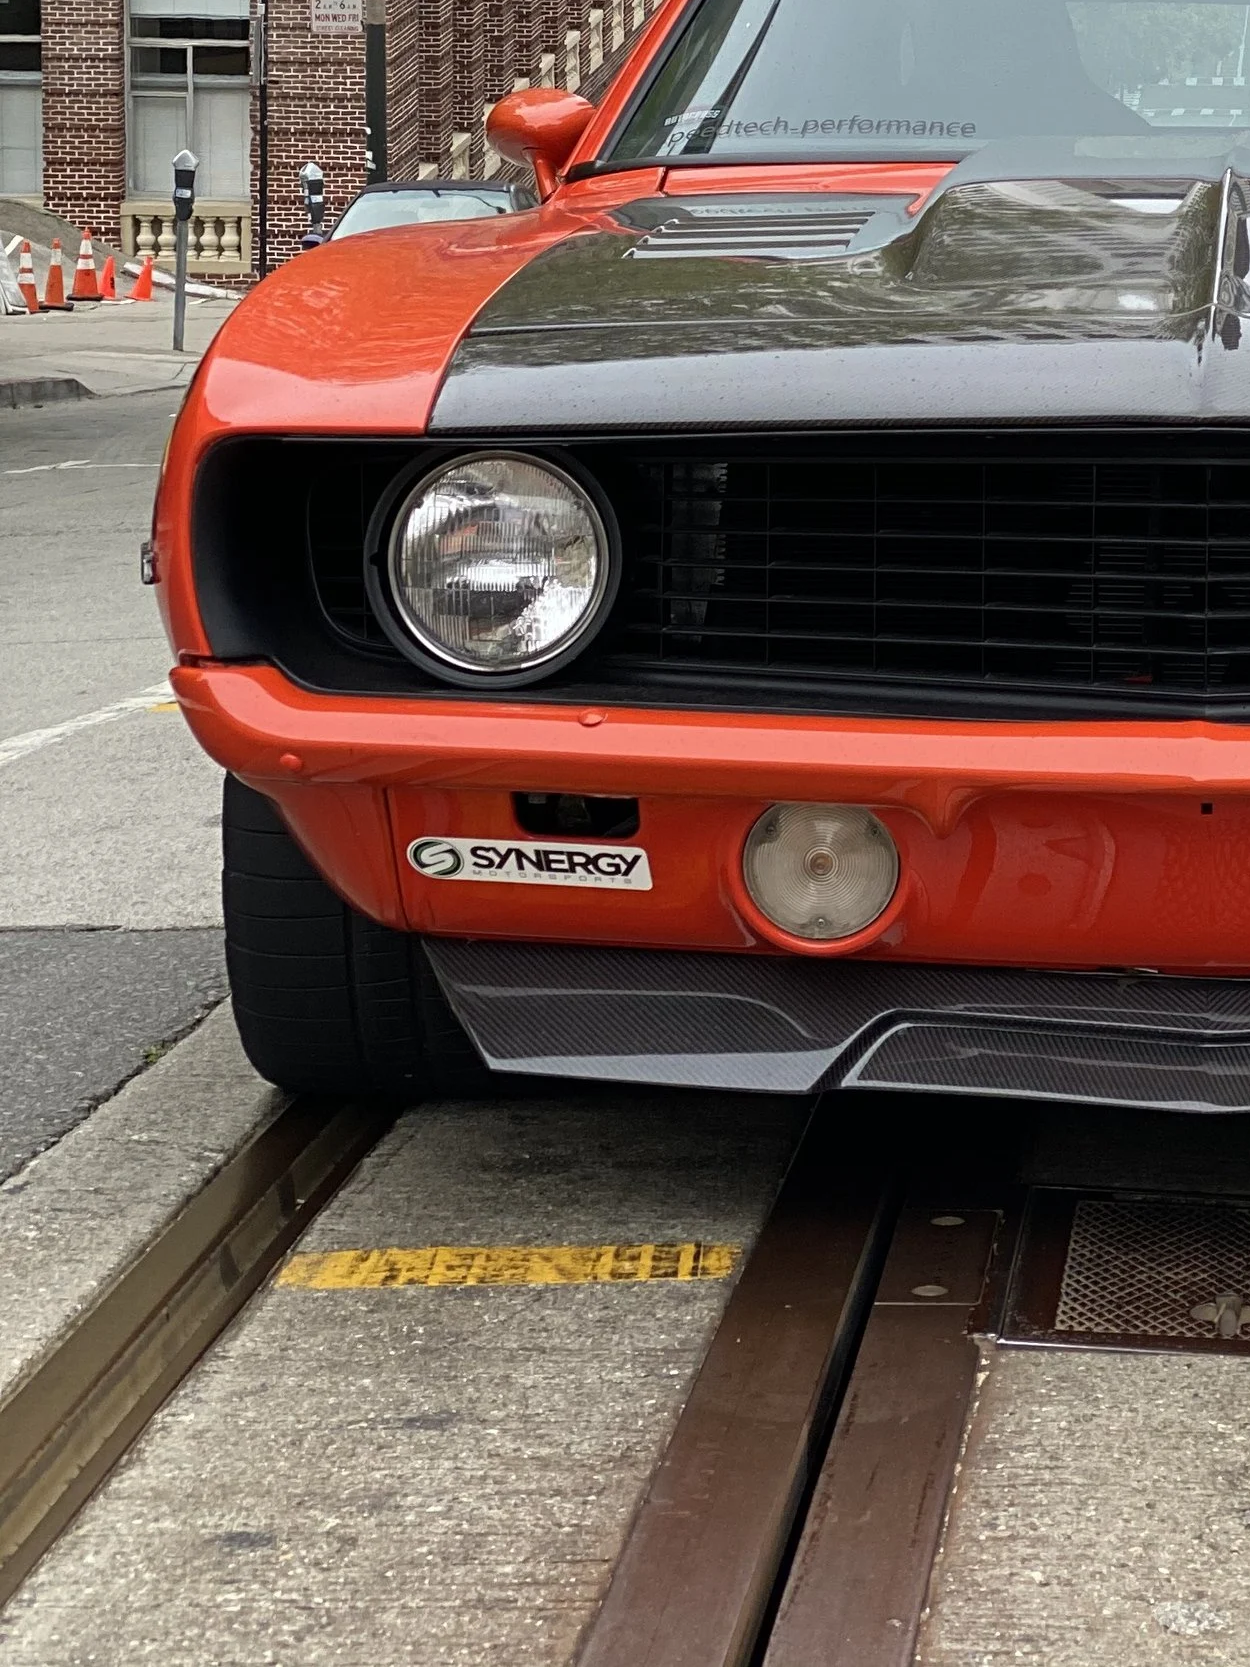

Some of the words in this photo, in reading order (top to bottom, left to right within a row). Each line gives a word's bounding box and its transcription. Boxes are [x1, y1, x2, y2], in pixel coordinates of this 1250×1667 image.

[315, 14, 330, 22] MON
[331, 14, 347, 23] WED
[664, 115, 977, 148] peedtech_performance
[470, 845, 642, 877] SYNERGY
[472, 869, 633, 884] MOTORSPORTS
